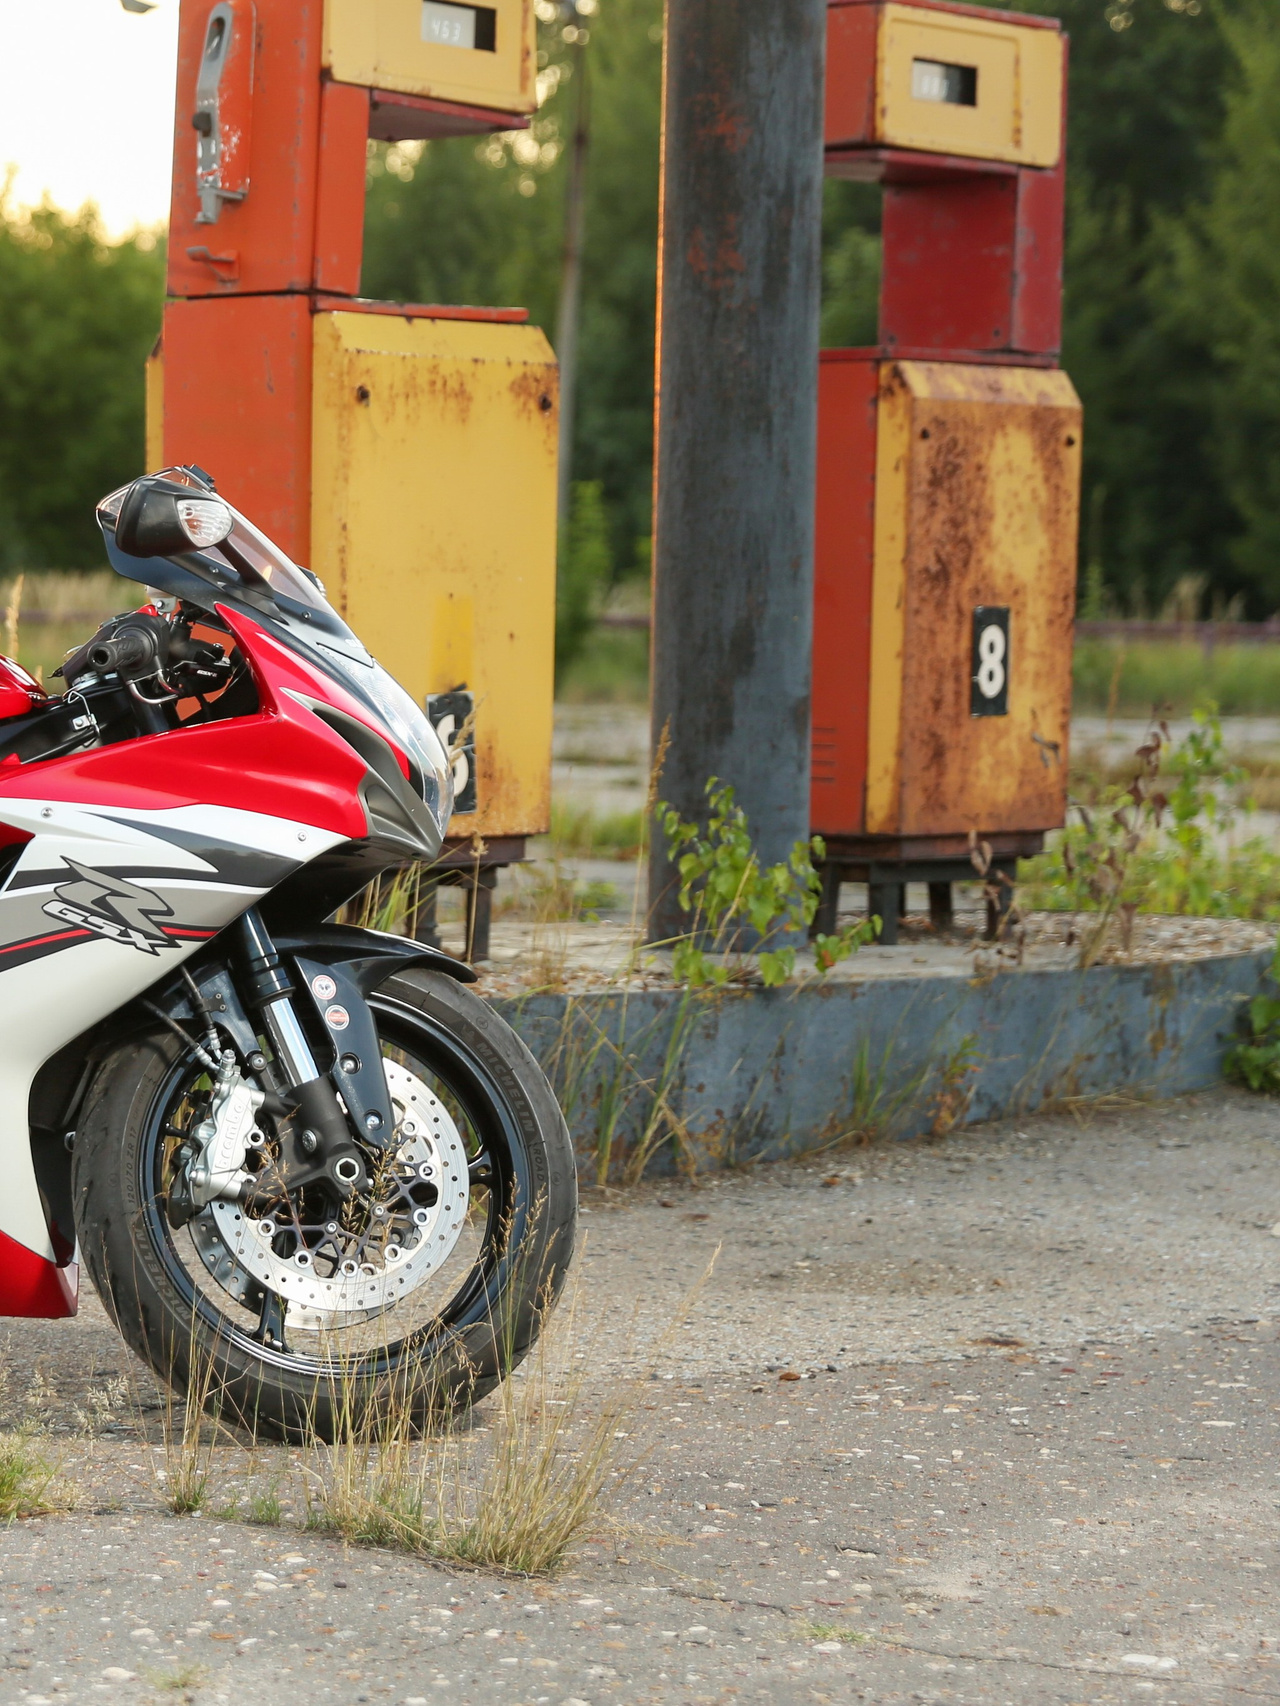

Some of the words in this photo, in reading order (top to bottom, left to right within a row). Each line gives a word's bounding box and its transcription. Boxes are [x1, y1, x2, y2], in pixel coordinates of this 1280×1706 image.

[978, 624, 1005, 699] 8
[436, 713, 469, 797] 6
[41, 899, 170, 956] GSX
[129, 1127, 138, 1138] 17
[215, 1104, 244, 1169] brembo
[476, 1042, 535, 1132] MICHELIN
[534, 1149, 545, 1181] ROAD
[126, 1163, 136, 1204] 120/70
[127, 1143, 136, 1159] ZR
[136, 1229, 192, 1320] MICHELIN
